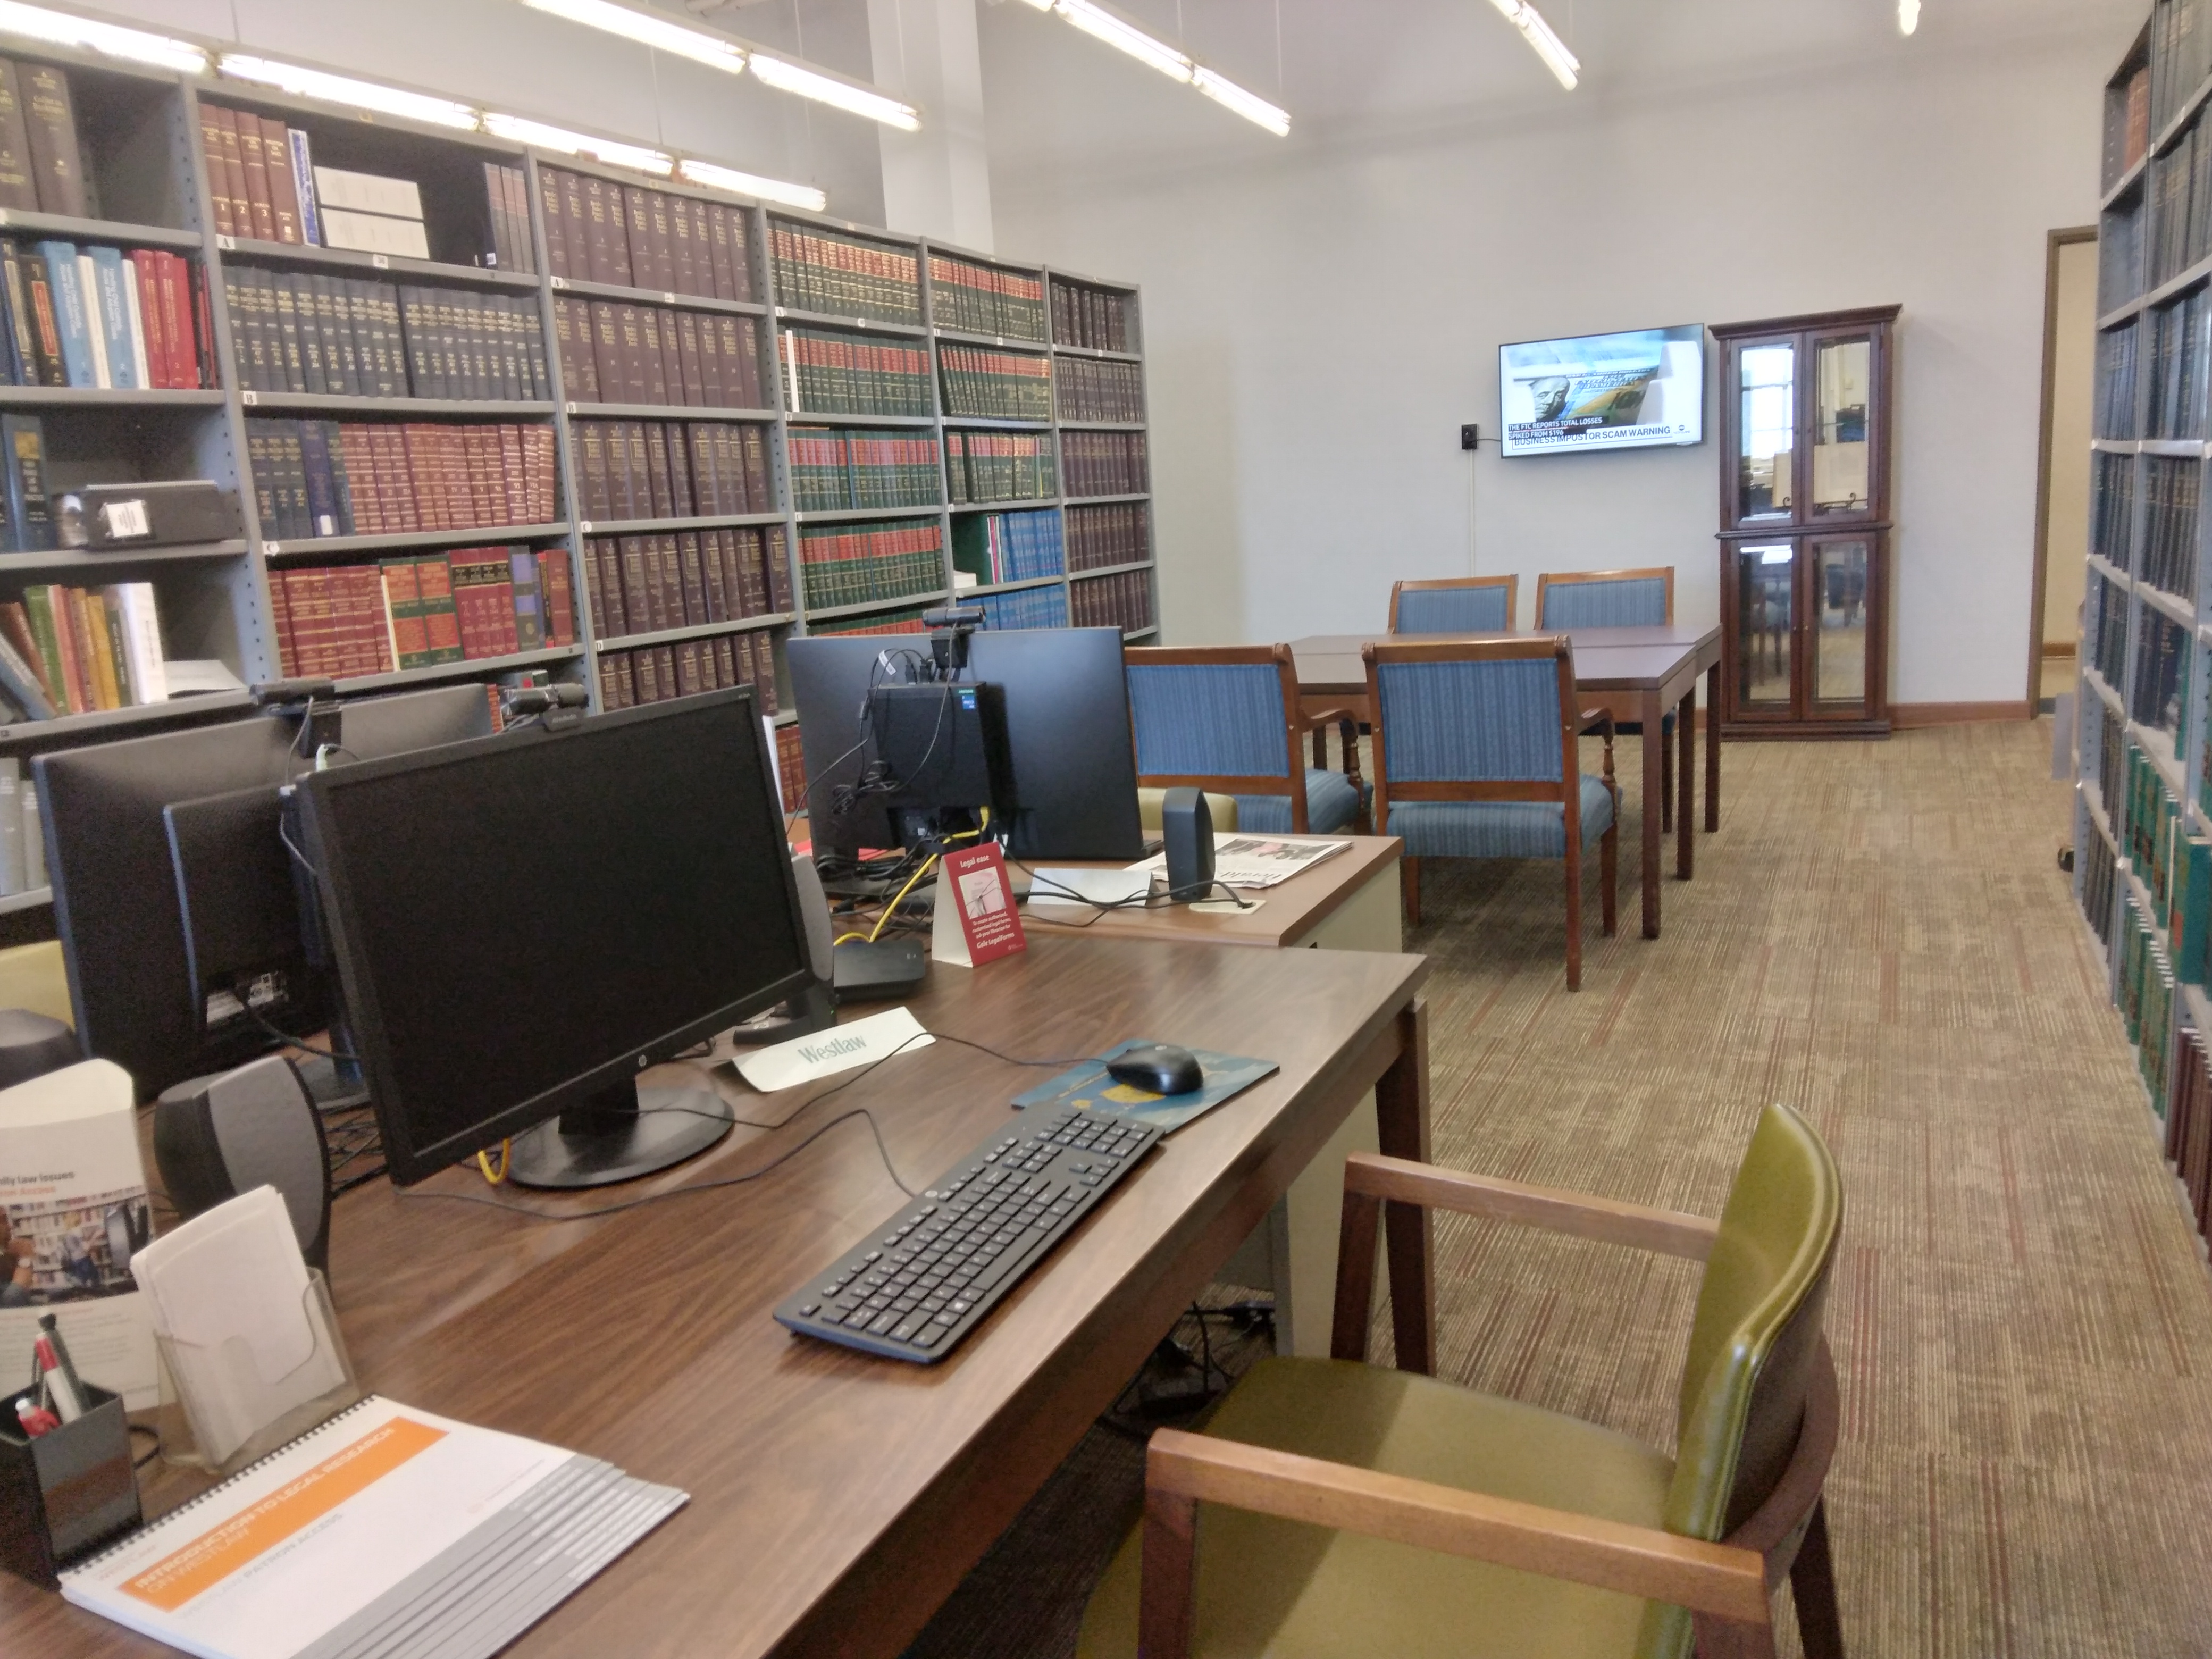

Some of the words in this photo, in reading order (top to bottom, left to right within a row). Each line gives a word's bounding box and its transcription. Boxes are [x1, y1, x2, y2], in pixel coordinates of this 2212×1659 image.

[222, 237, 231, 249] A
[1532, 421, 1560, 430] REPORTS
[1579, 417, 1603, 425] LOSSES
[1557, 431, 1601, 443] IMPOSTOR
[1602, 428, 1627, 439] SCAM
[1628, 426, 1671, 438] WARNING
[960, 857, 976, 868] Legal
[977, 854, 990, 863] ease
[976, 940, 988, 949] Gale
[798, 1035, 867, 1064] Westlaw
[135, 1510, 256, 1588] INTRODUCTION
[277, 1470, 325, 1503] LEGAL
[324, 1428, 396, 1474] RESEARCH
